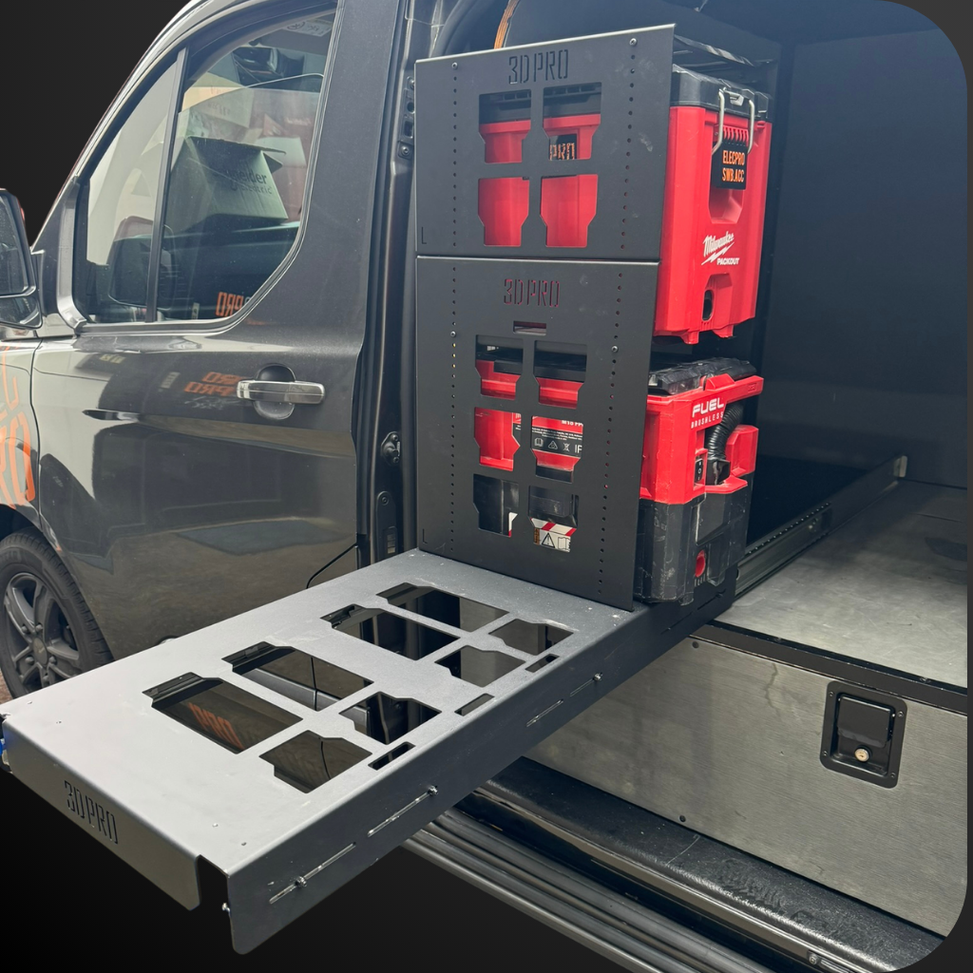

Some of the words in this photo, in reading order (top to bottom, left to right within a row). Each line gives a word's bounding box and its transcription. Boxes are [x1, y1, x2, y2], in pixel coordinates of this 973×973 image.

[722, 149, 745, 166] ELECPRO
[702, 231, 735, 258] Milwaukee
[717, 257, 740, 266] PACKOUT
[692, 397, 725, 418] FUEL
[691, 411, 725, 429] BRUSHLESS
